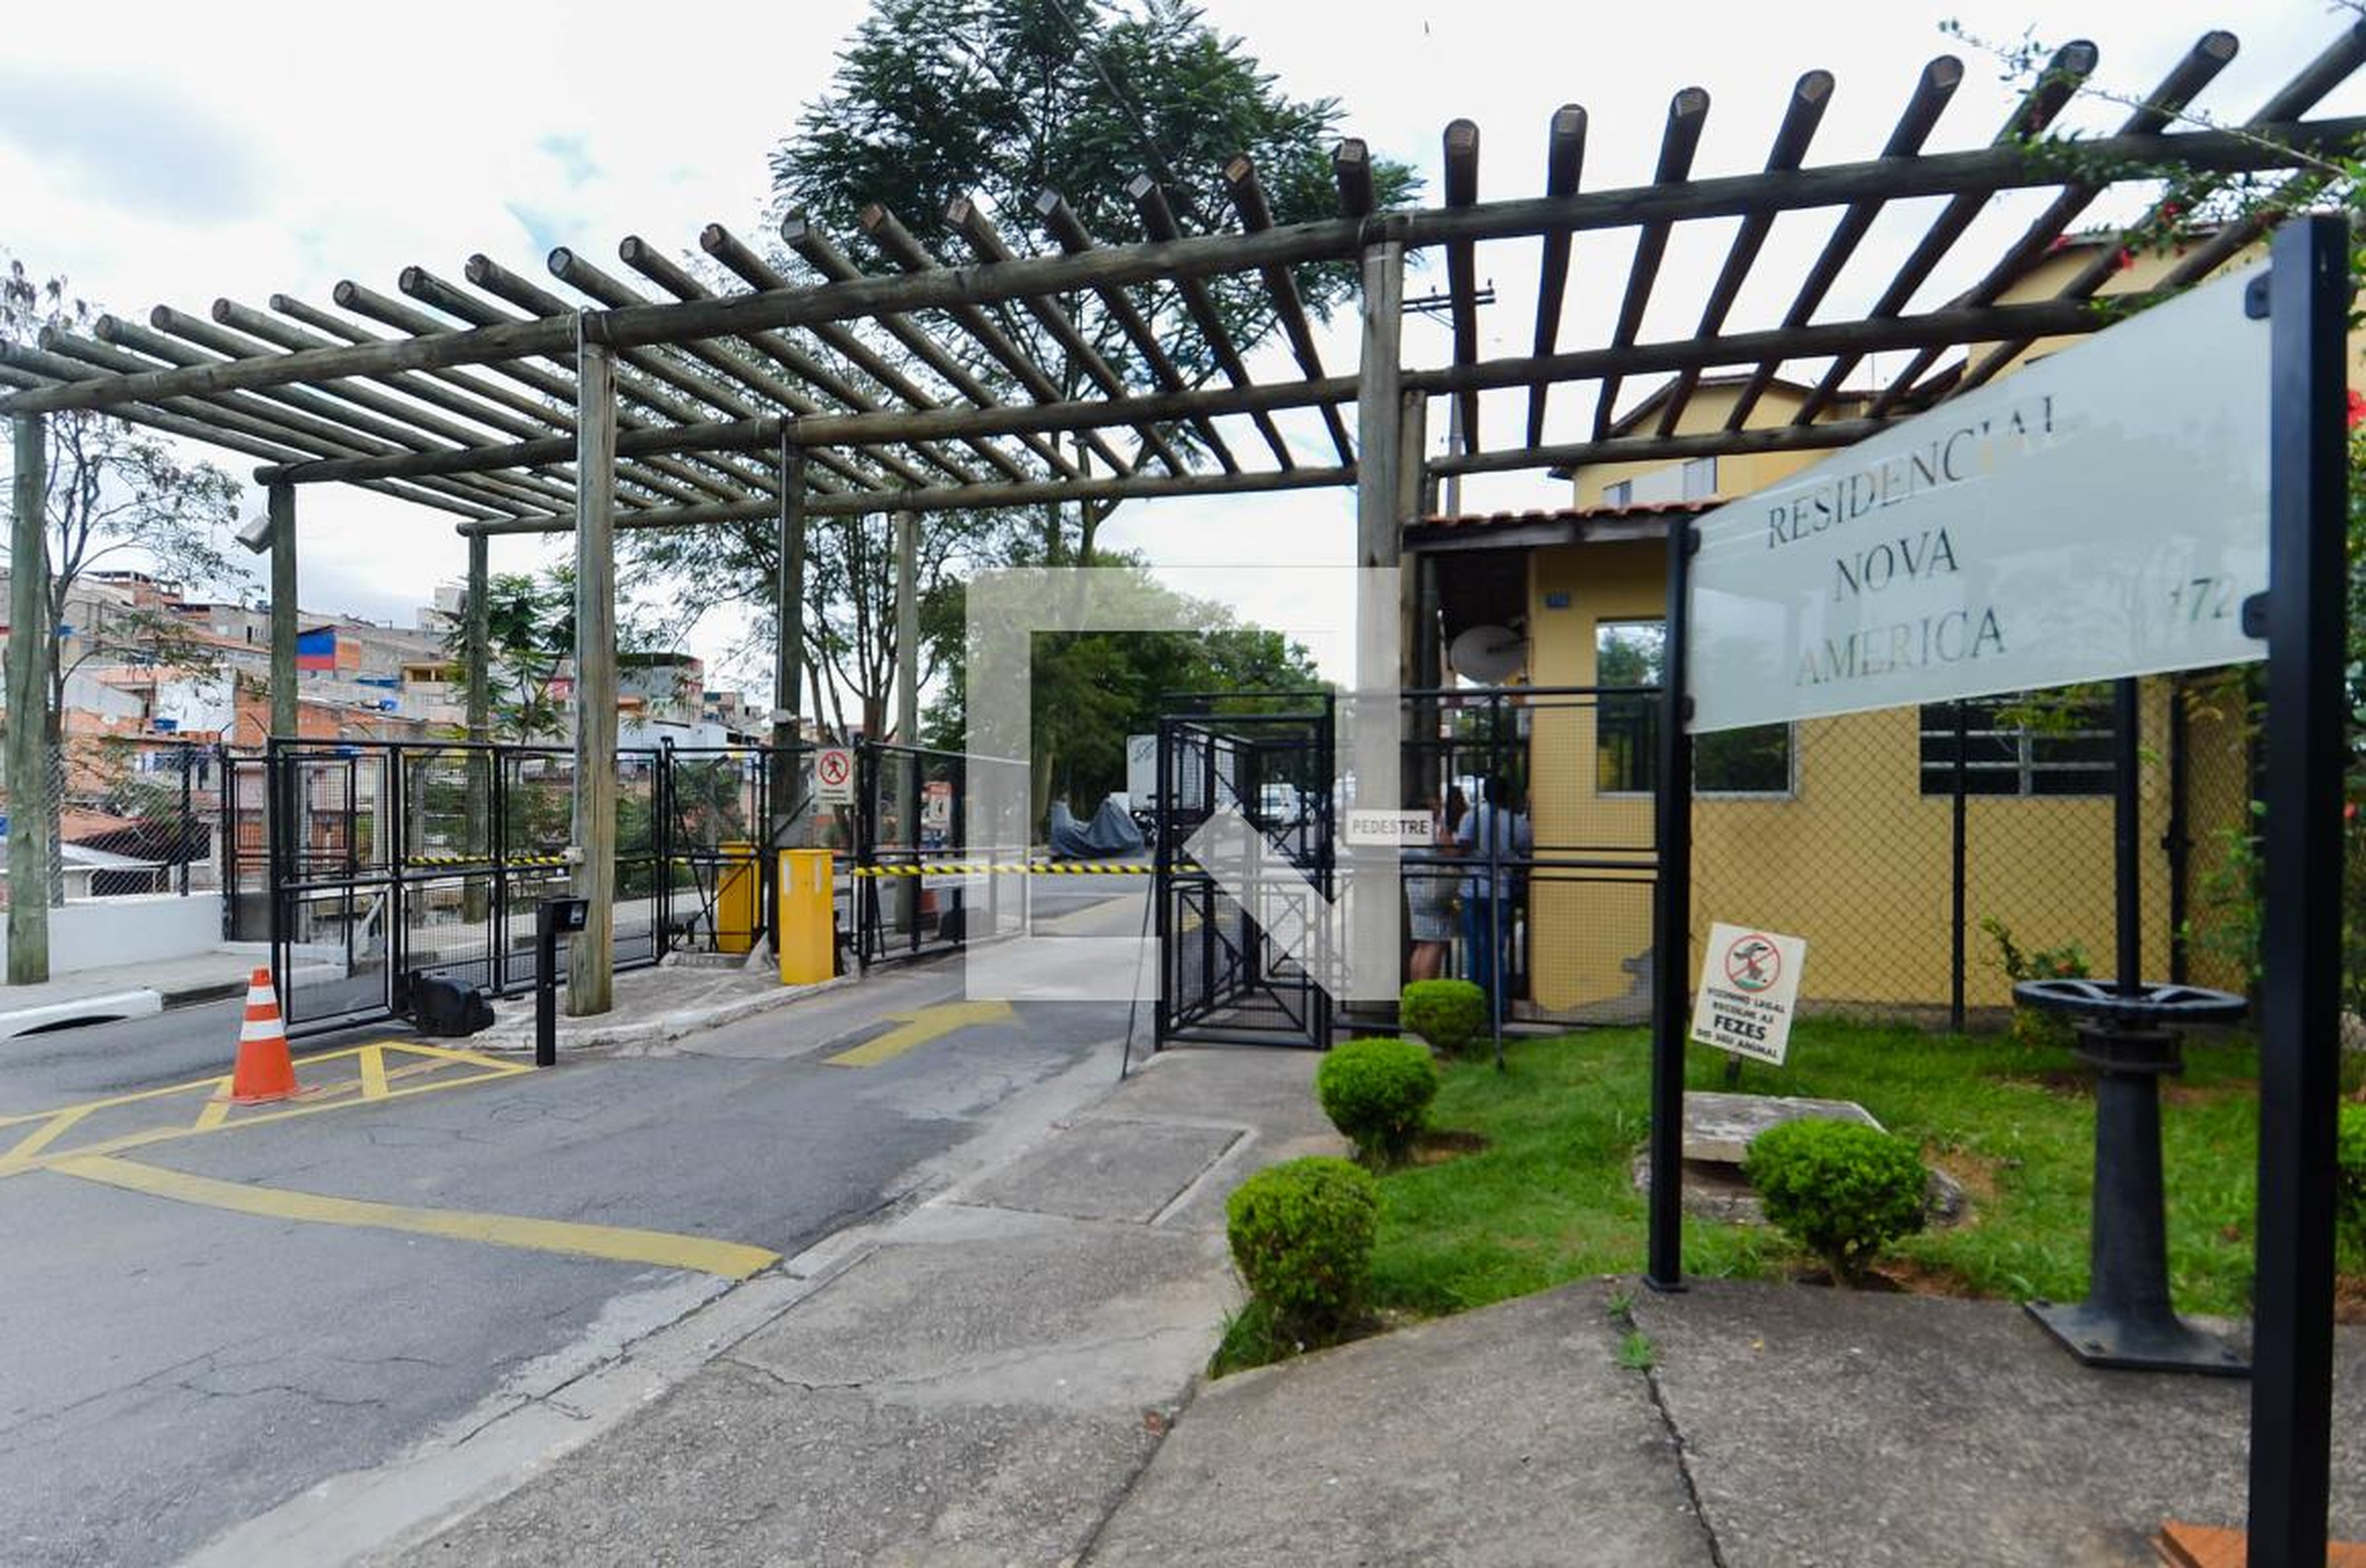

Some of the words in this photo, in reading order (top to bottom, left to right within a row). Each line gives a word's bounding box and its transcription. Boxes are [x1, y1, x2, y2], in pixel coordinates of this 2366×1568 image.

[1834, 525, 1960, 603] NOVA
[1795, 606, 2006, 687] AMERICA
[1352, 819, 1430, 835] PEDESTRE
[1714, 1014, 1766, 1041] FEZES
